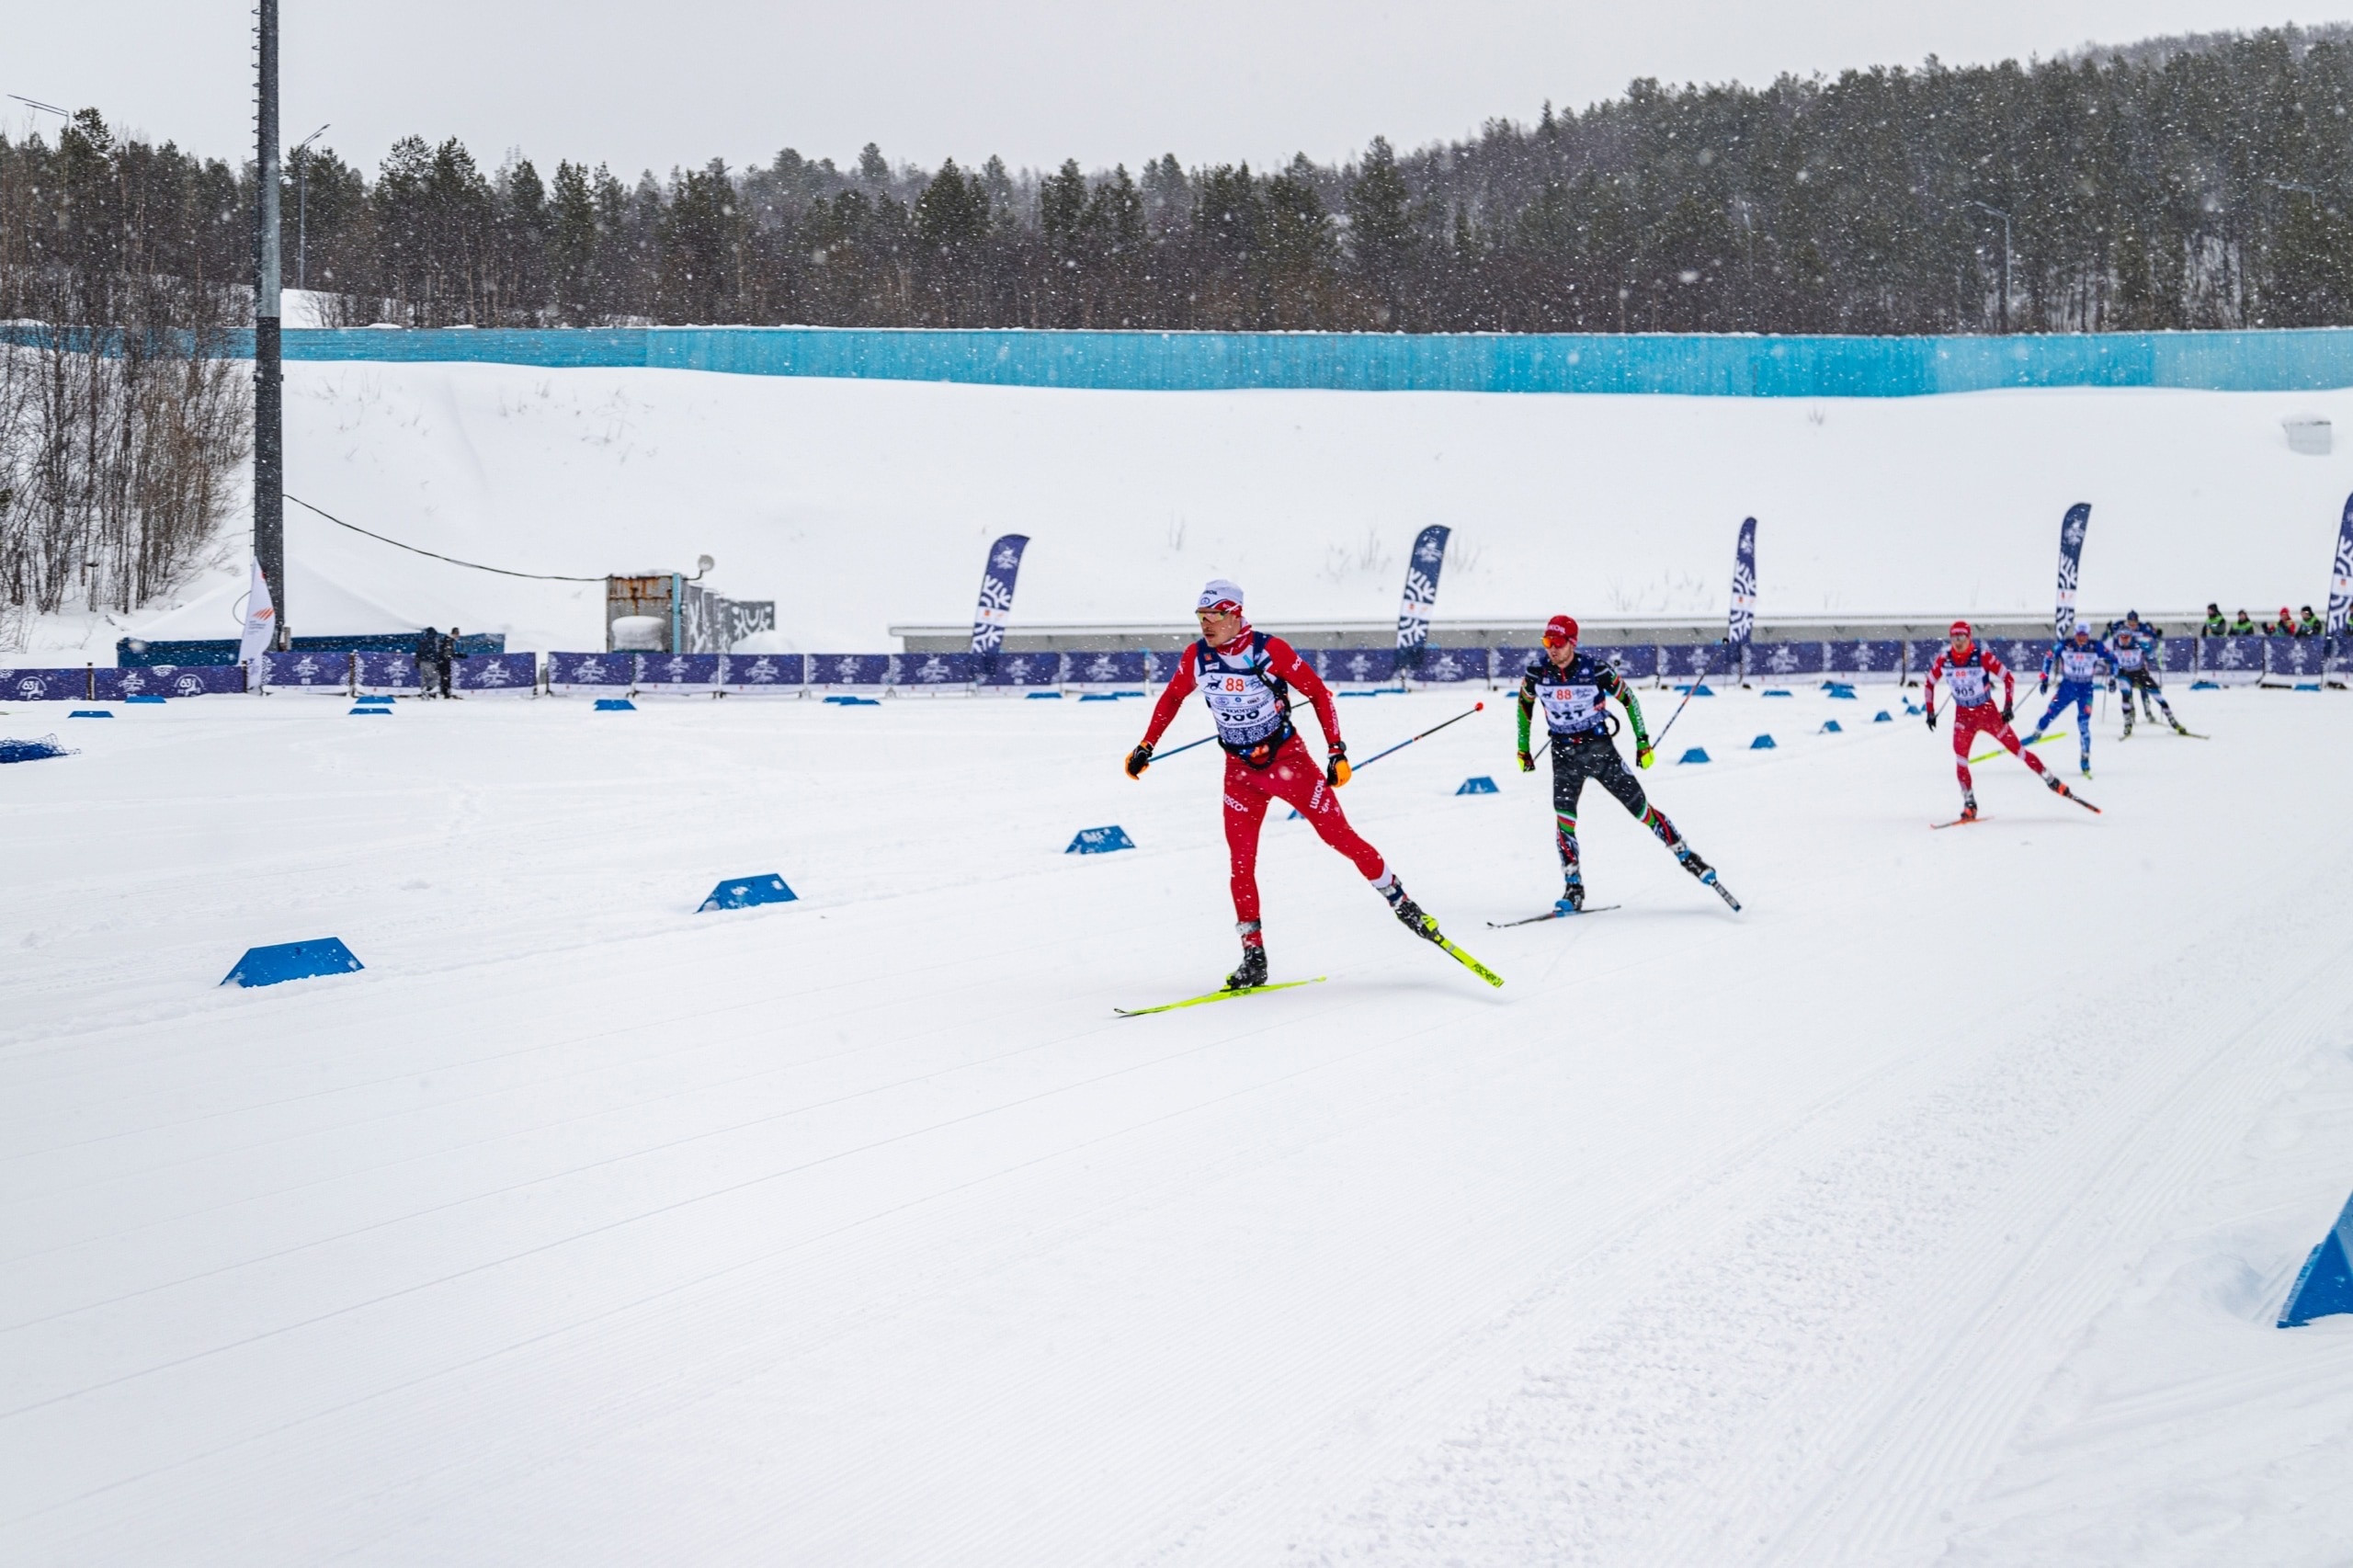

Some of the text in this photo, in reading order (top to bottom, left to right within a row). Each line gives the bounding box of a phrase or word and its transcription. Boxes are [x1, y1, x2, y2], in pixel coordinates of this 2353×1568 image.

[21, 680, 34, 690] 63
[179, 677, 192, 687] 63
[1225, 677, 1245, 692] 88
[1556, 688, 1573, 700] 88
[1954, 687, 1975, 697] 905
[1309, 778, 1324, 809] LUKOIL
